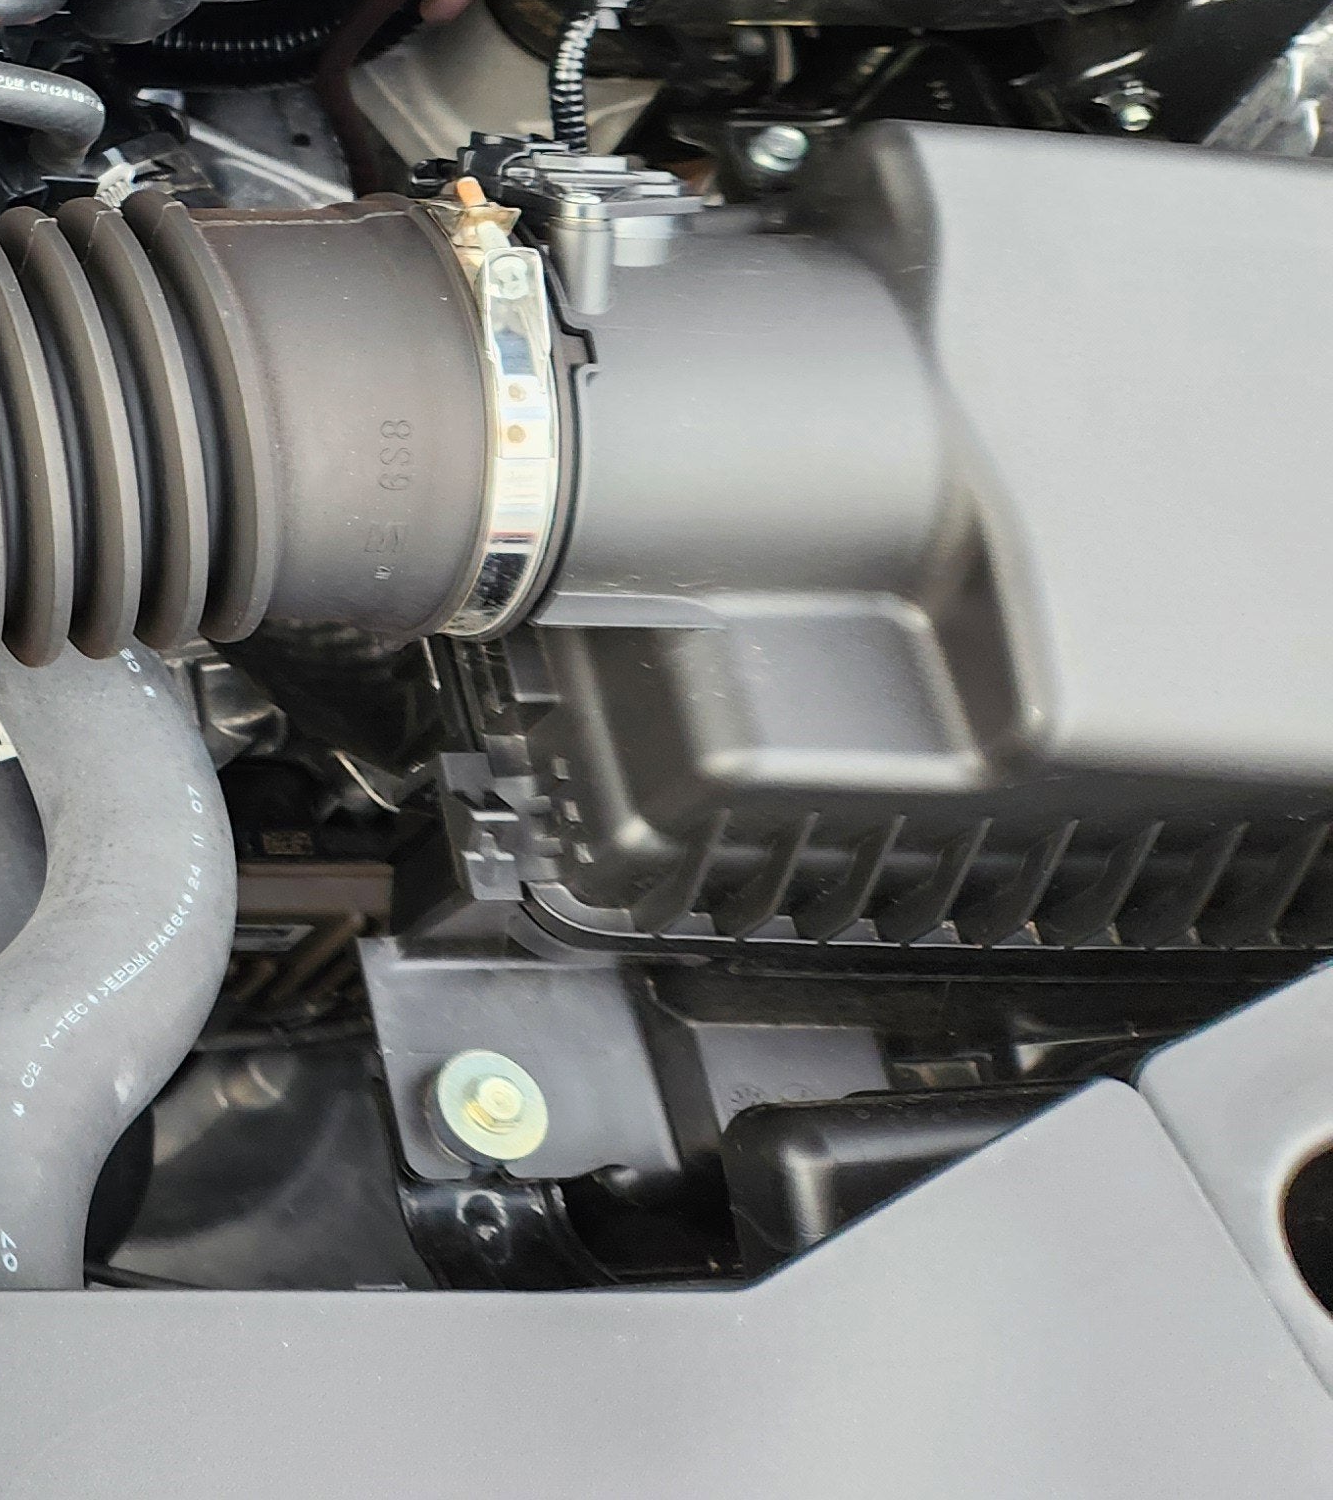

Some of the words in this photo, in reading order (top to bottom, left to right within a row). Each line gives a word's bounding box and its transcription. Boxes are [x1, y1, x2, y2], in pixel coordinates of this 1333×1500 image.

[20, 1060, 42, 1089] C2
[39, 1002, 89, 1051] Y-TEC
[187, 863, 202, 891] 24
